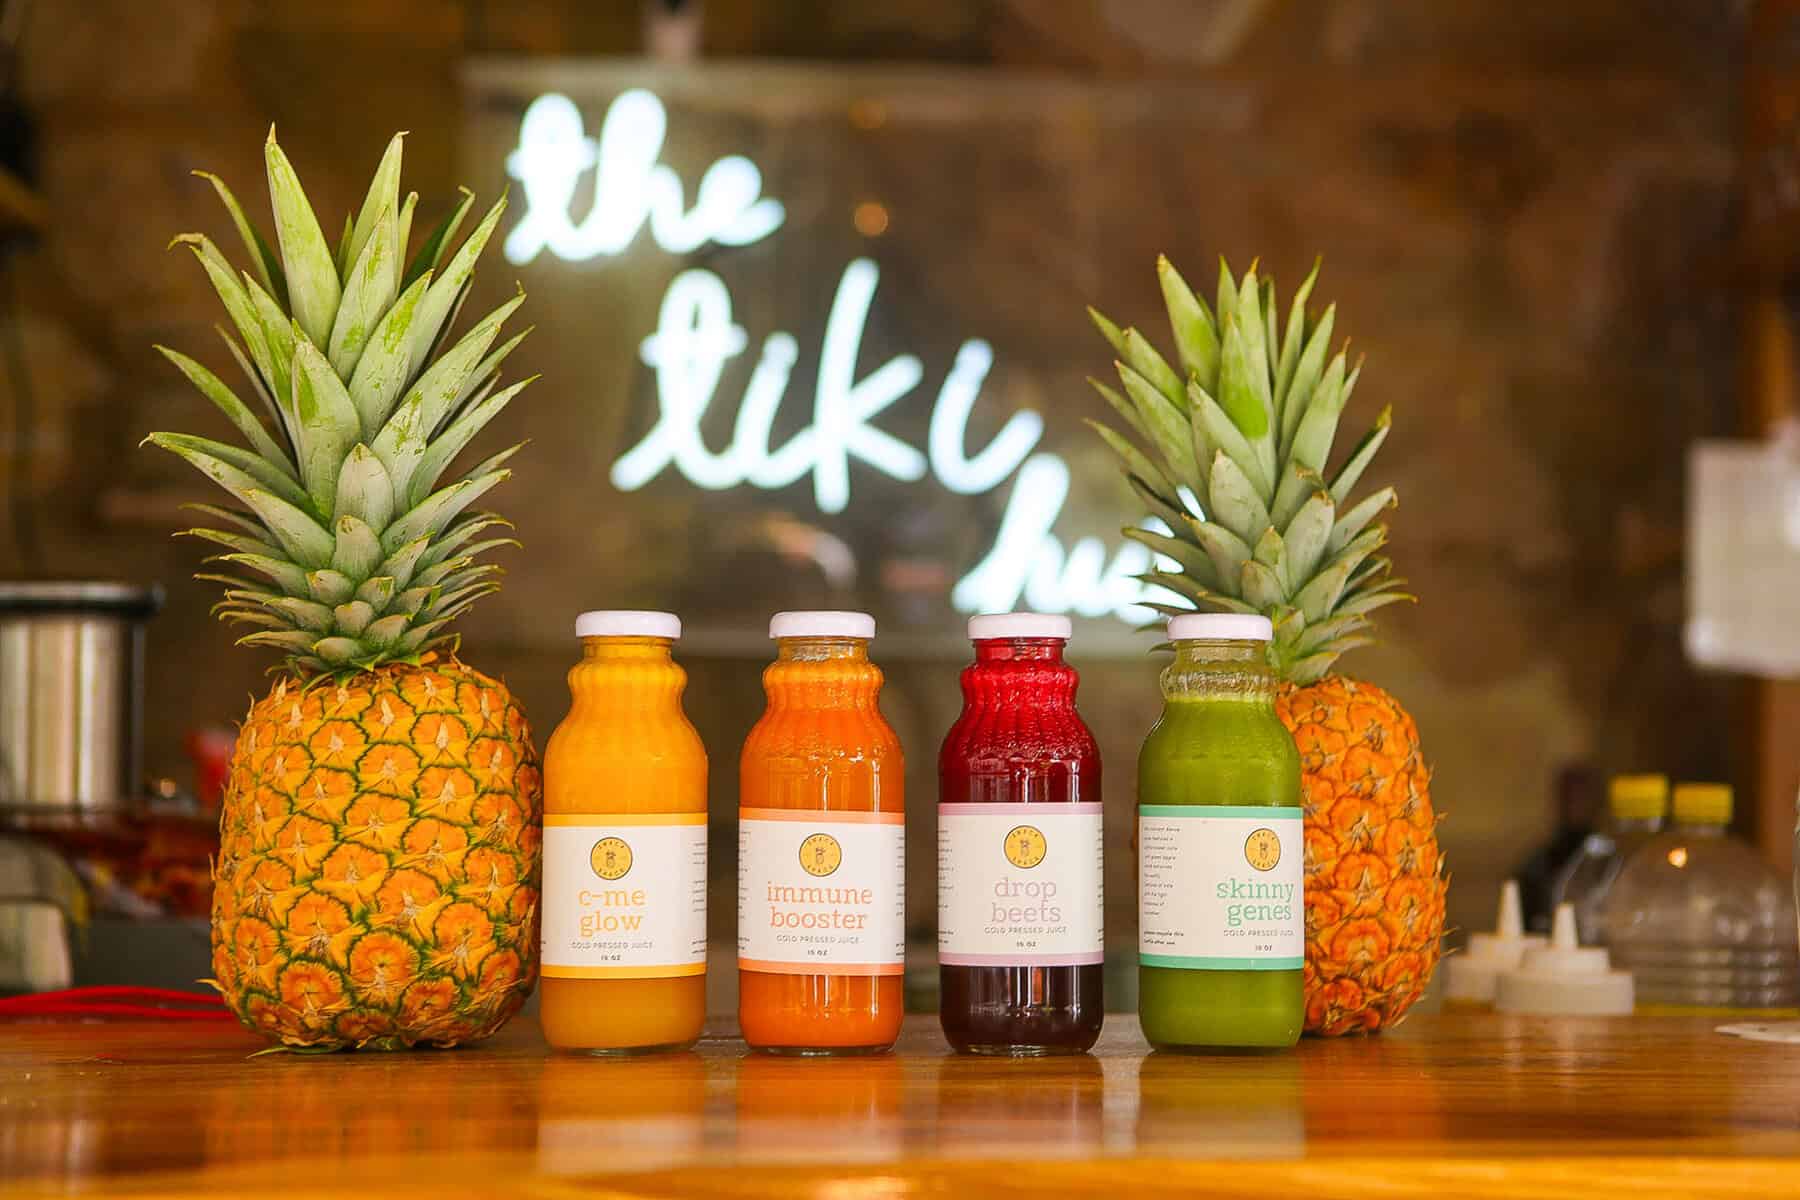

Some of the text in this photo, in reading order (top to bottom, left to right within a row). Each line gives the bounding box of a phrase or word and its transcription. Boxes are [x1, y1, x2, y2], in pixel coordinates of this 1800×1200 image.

[505, 88, 787, 265] the
[610, 257, 1043, 514] tiki
[578, 888, 646, 907] c-me
[767, 880, 873, 905] immune
[994, 877, 1057, 901] drop
[1216, 877, 1295, 902] skinny
[580, 910, 643, 938] glow
[769, 906, 868, 930] booster
[1227, 903, 1292, 927] genes
